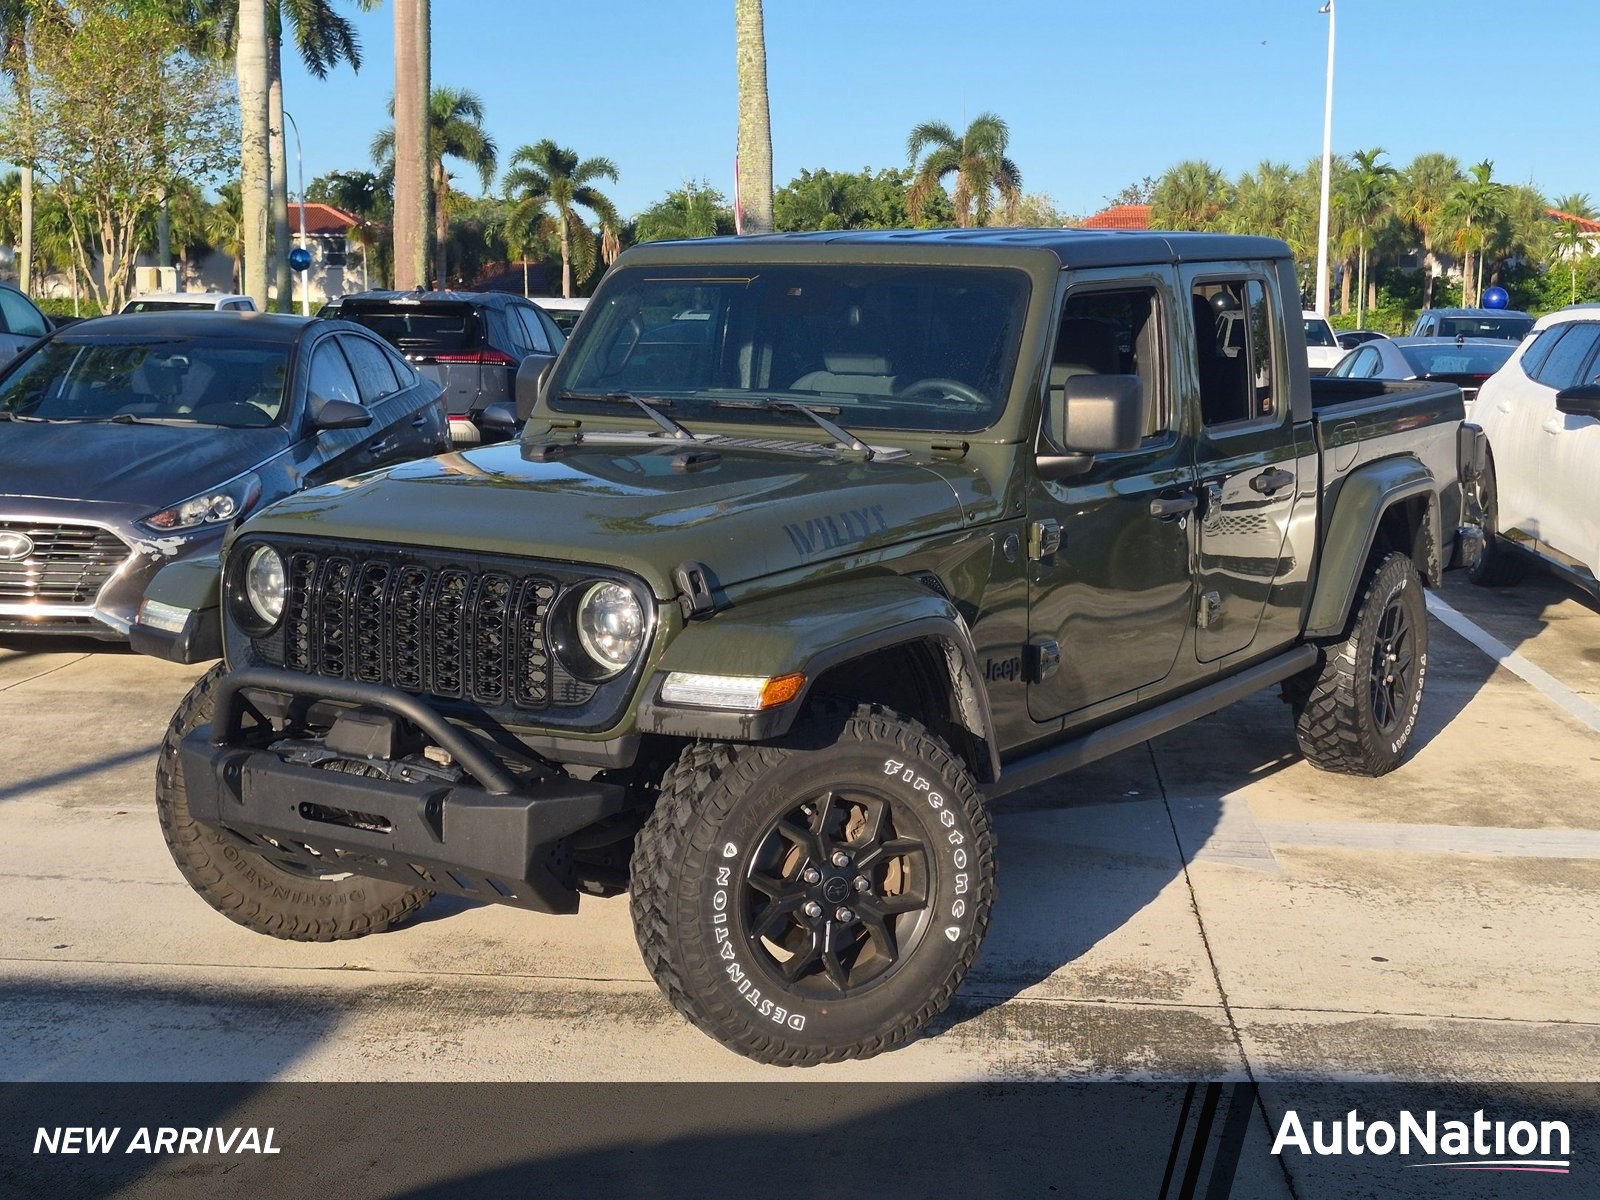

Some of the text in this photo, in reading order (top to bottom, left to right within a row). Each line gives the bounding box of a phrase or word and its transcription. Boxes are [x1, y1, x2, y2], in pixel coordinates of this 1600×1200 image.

[783, 504, 888, 555] WILLYS
[983, 656, 1021, 682] Jeep
[713, 867, 806, 1031] DESTINATION
